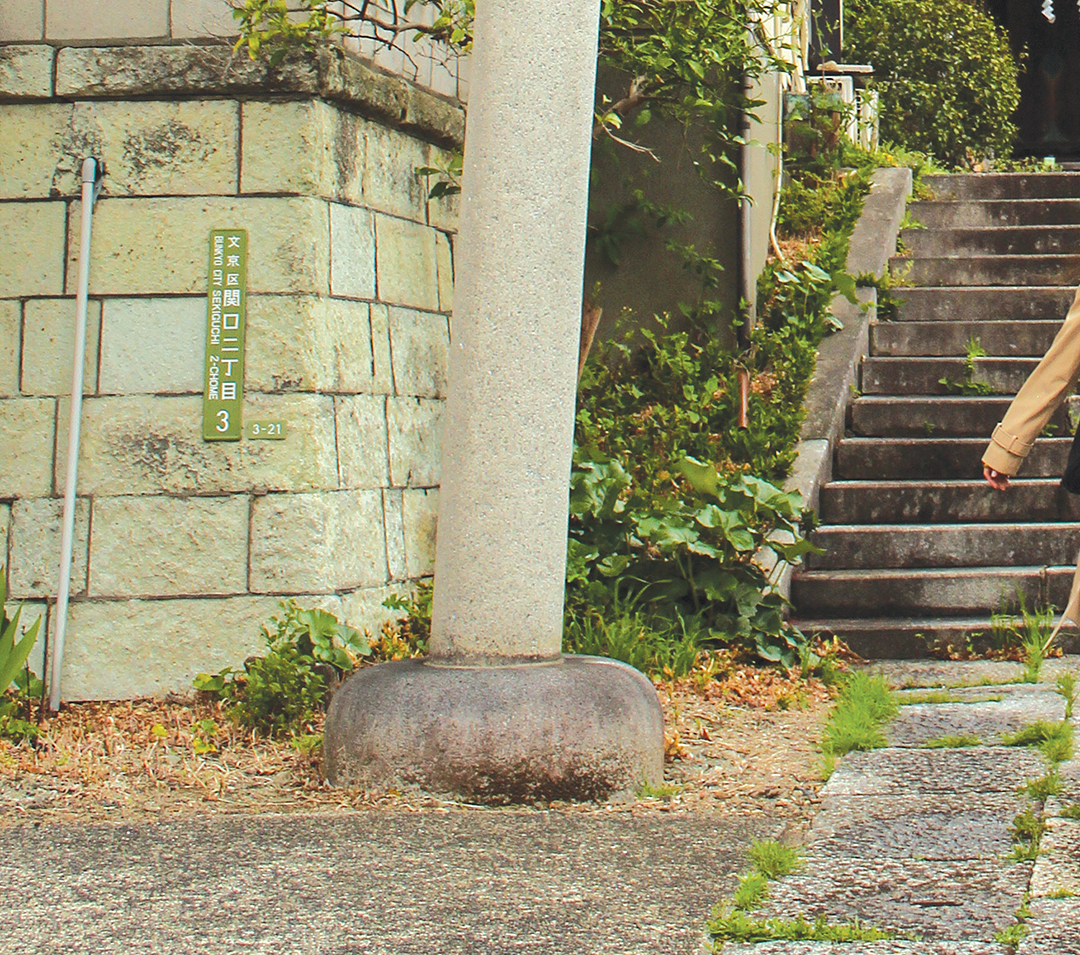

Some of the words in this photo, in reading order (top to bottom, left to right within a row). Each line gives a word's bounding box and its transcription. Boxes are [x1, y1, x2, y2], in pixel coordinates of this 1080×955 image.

[214, 235, 224, 266] BUNKYO
[212, 269, 223, 286] CITY
[210, 289, 222, 345] SEKIGUCHI
[208, 355, 219, 400] 2-CHOME
[216, 409, 229, 432] 3
[252, 422, 281, 435] 3-21
